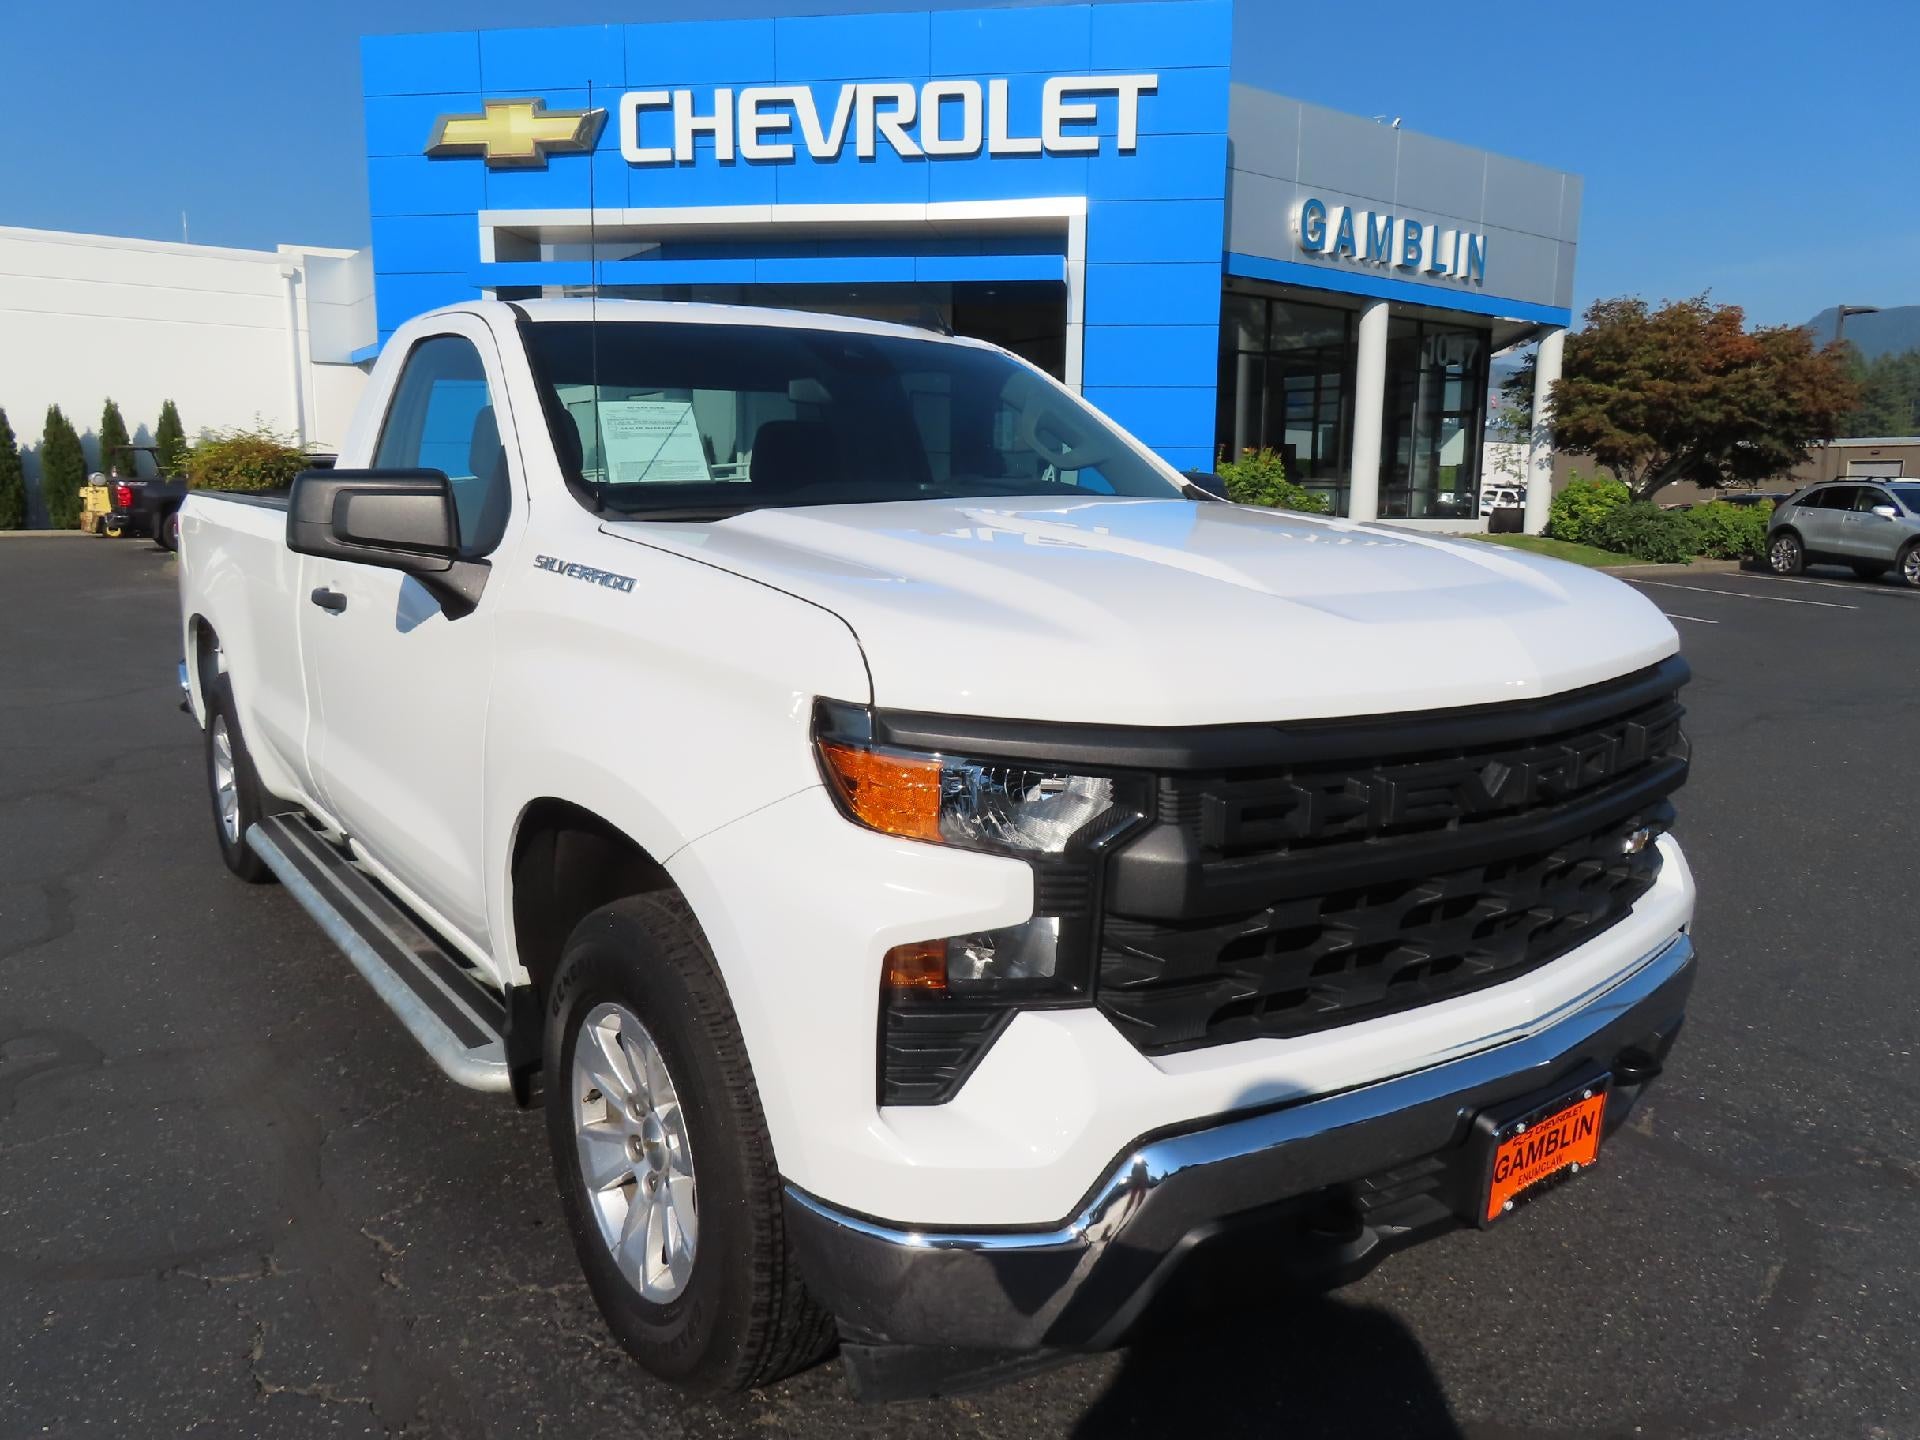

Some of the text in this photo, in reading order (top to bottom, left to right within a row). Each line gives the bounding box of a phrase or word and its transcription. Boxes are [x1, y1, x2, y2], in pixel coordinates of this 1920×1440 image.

[618, 74, 1158, 164] CHEVROLET
[1298, 198, 1488, 288] GAMBLIN
[533, 554, 638, 593] SILVERADO
[1494, 1111, 1596, 1184] GAMBLIN
[1518, 1153, 1564, 1186] ENUMCLAW
